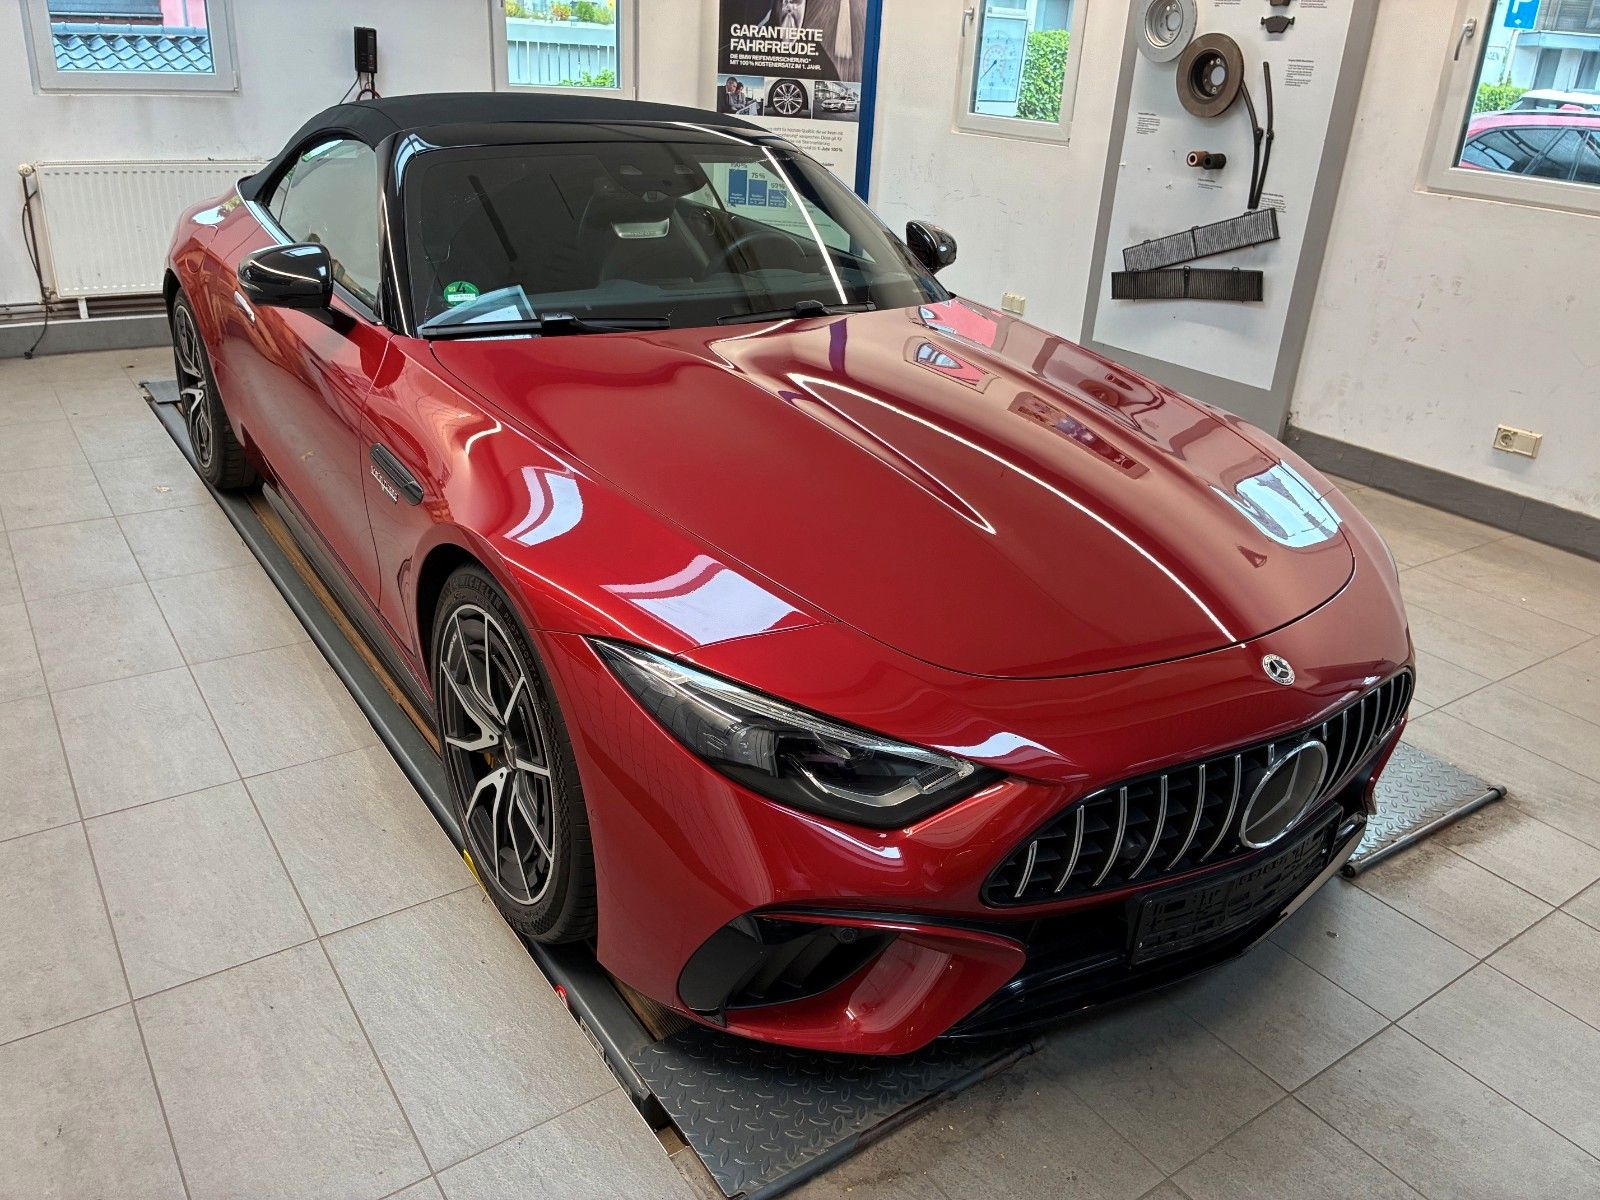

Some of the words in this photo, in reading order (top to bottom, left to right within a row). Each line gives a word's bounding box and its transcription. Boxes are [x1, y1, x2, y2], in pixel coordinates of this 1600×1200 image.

[730, 24, 823, 41] GARANTIERTE
[730, 39, 818, 56] FAHRFREUDE.
[455, 281, 467, 294] 4
